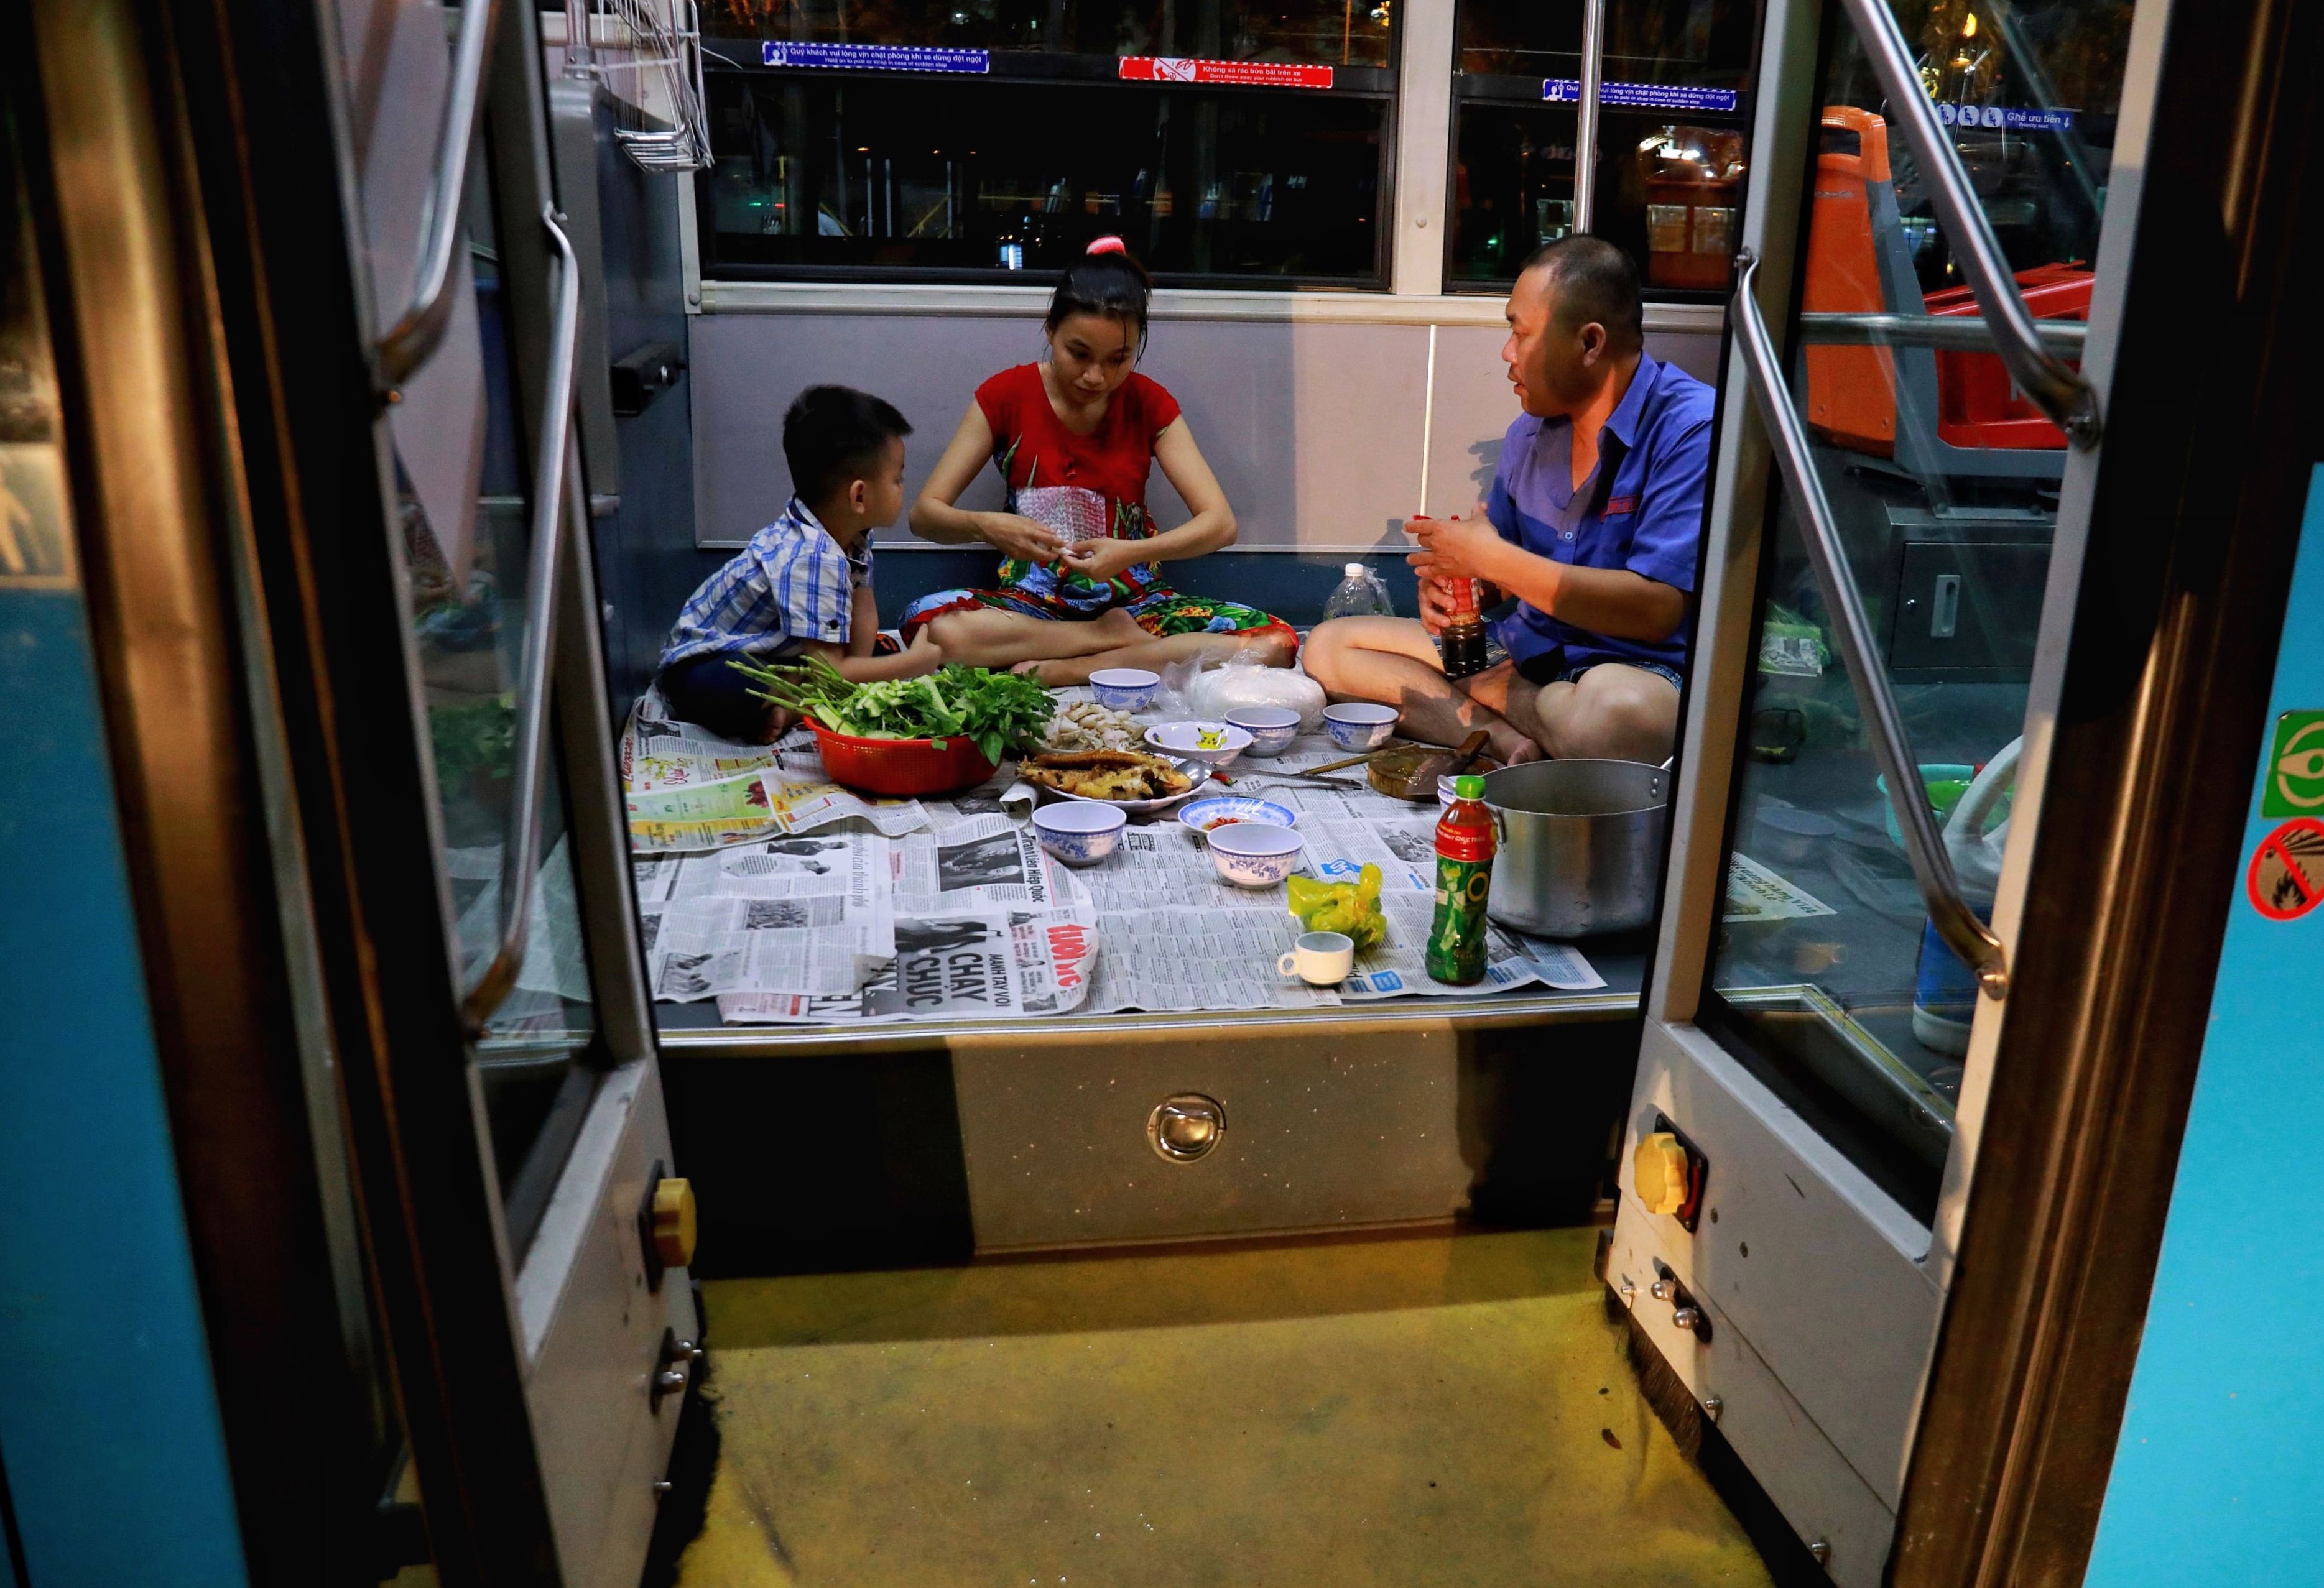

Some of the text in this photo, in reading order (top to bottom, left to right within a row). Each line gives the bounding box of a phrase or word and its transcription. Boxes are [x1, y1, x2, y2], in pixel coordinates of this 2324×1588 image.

[790, 47, 805, 57] Quý
[807, 48, 827, 57] khách
[841, 50, 856, 58] lòng
[933, 54, 951, 62] dừng
[953, 55, 964, 63] đột
[966, 56, 981, 64] ngột
[1203, 66, 1226, 74] Không
[1649, 90, 1669, 98] phòng
[2007, 111, 2026, 122] Ghế
[2044, 114, 2061, 123] tiên
[1025, 855, 1039, 867] Liên
[1026, 869, 1042, 884] Hiệp
[1028, 885, 1047, 902] Quốc
[948, 953, 988, 1002] CHẠY
[992, 976, 1009, 990] TAY
